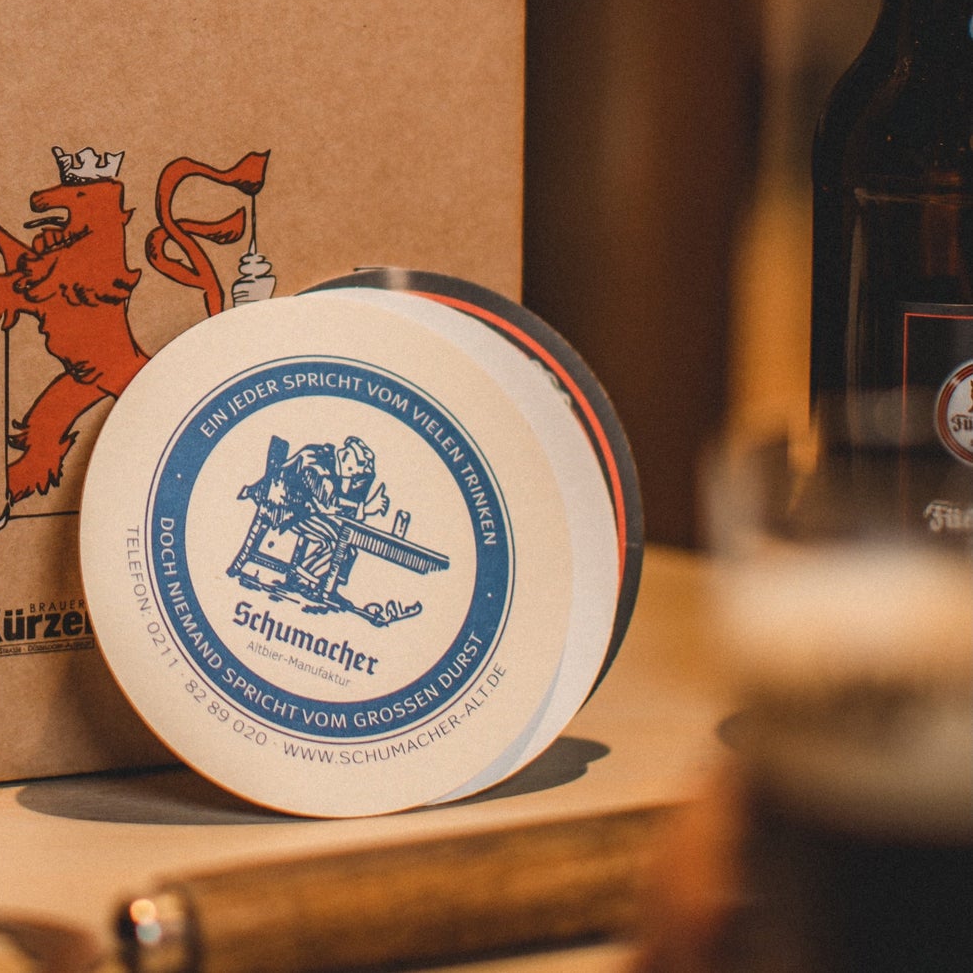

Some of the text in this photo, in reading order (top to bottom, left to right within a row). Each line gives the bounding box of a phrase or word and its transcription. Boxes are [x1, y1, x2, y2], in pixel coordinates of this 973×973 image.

[199, 372, 497, 545] EIN JEDER SPRICHT VOM VIELEN TRINKEN
[29, 599, 85, 613] BRAUER
[127, 525, 507, 765] TELEFON: 0211 82 89 020 WWW.SCHUMACHER-ALT.DE
[160, 516, 484, 728] DOCH NIEMAND SPRICHT VOM GROSSEN DURST
[232, 600, 379, 676] Schumacher
[246, 640, 351, 688] Altbier-Manufaktur
